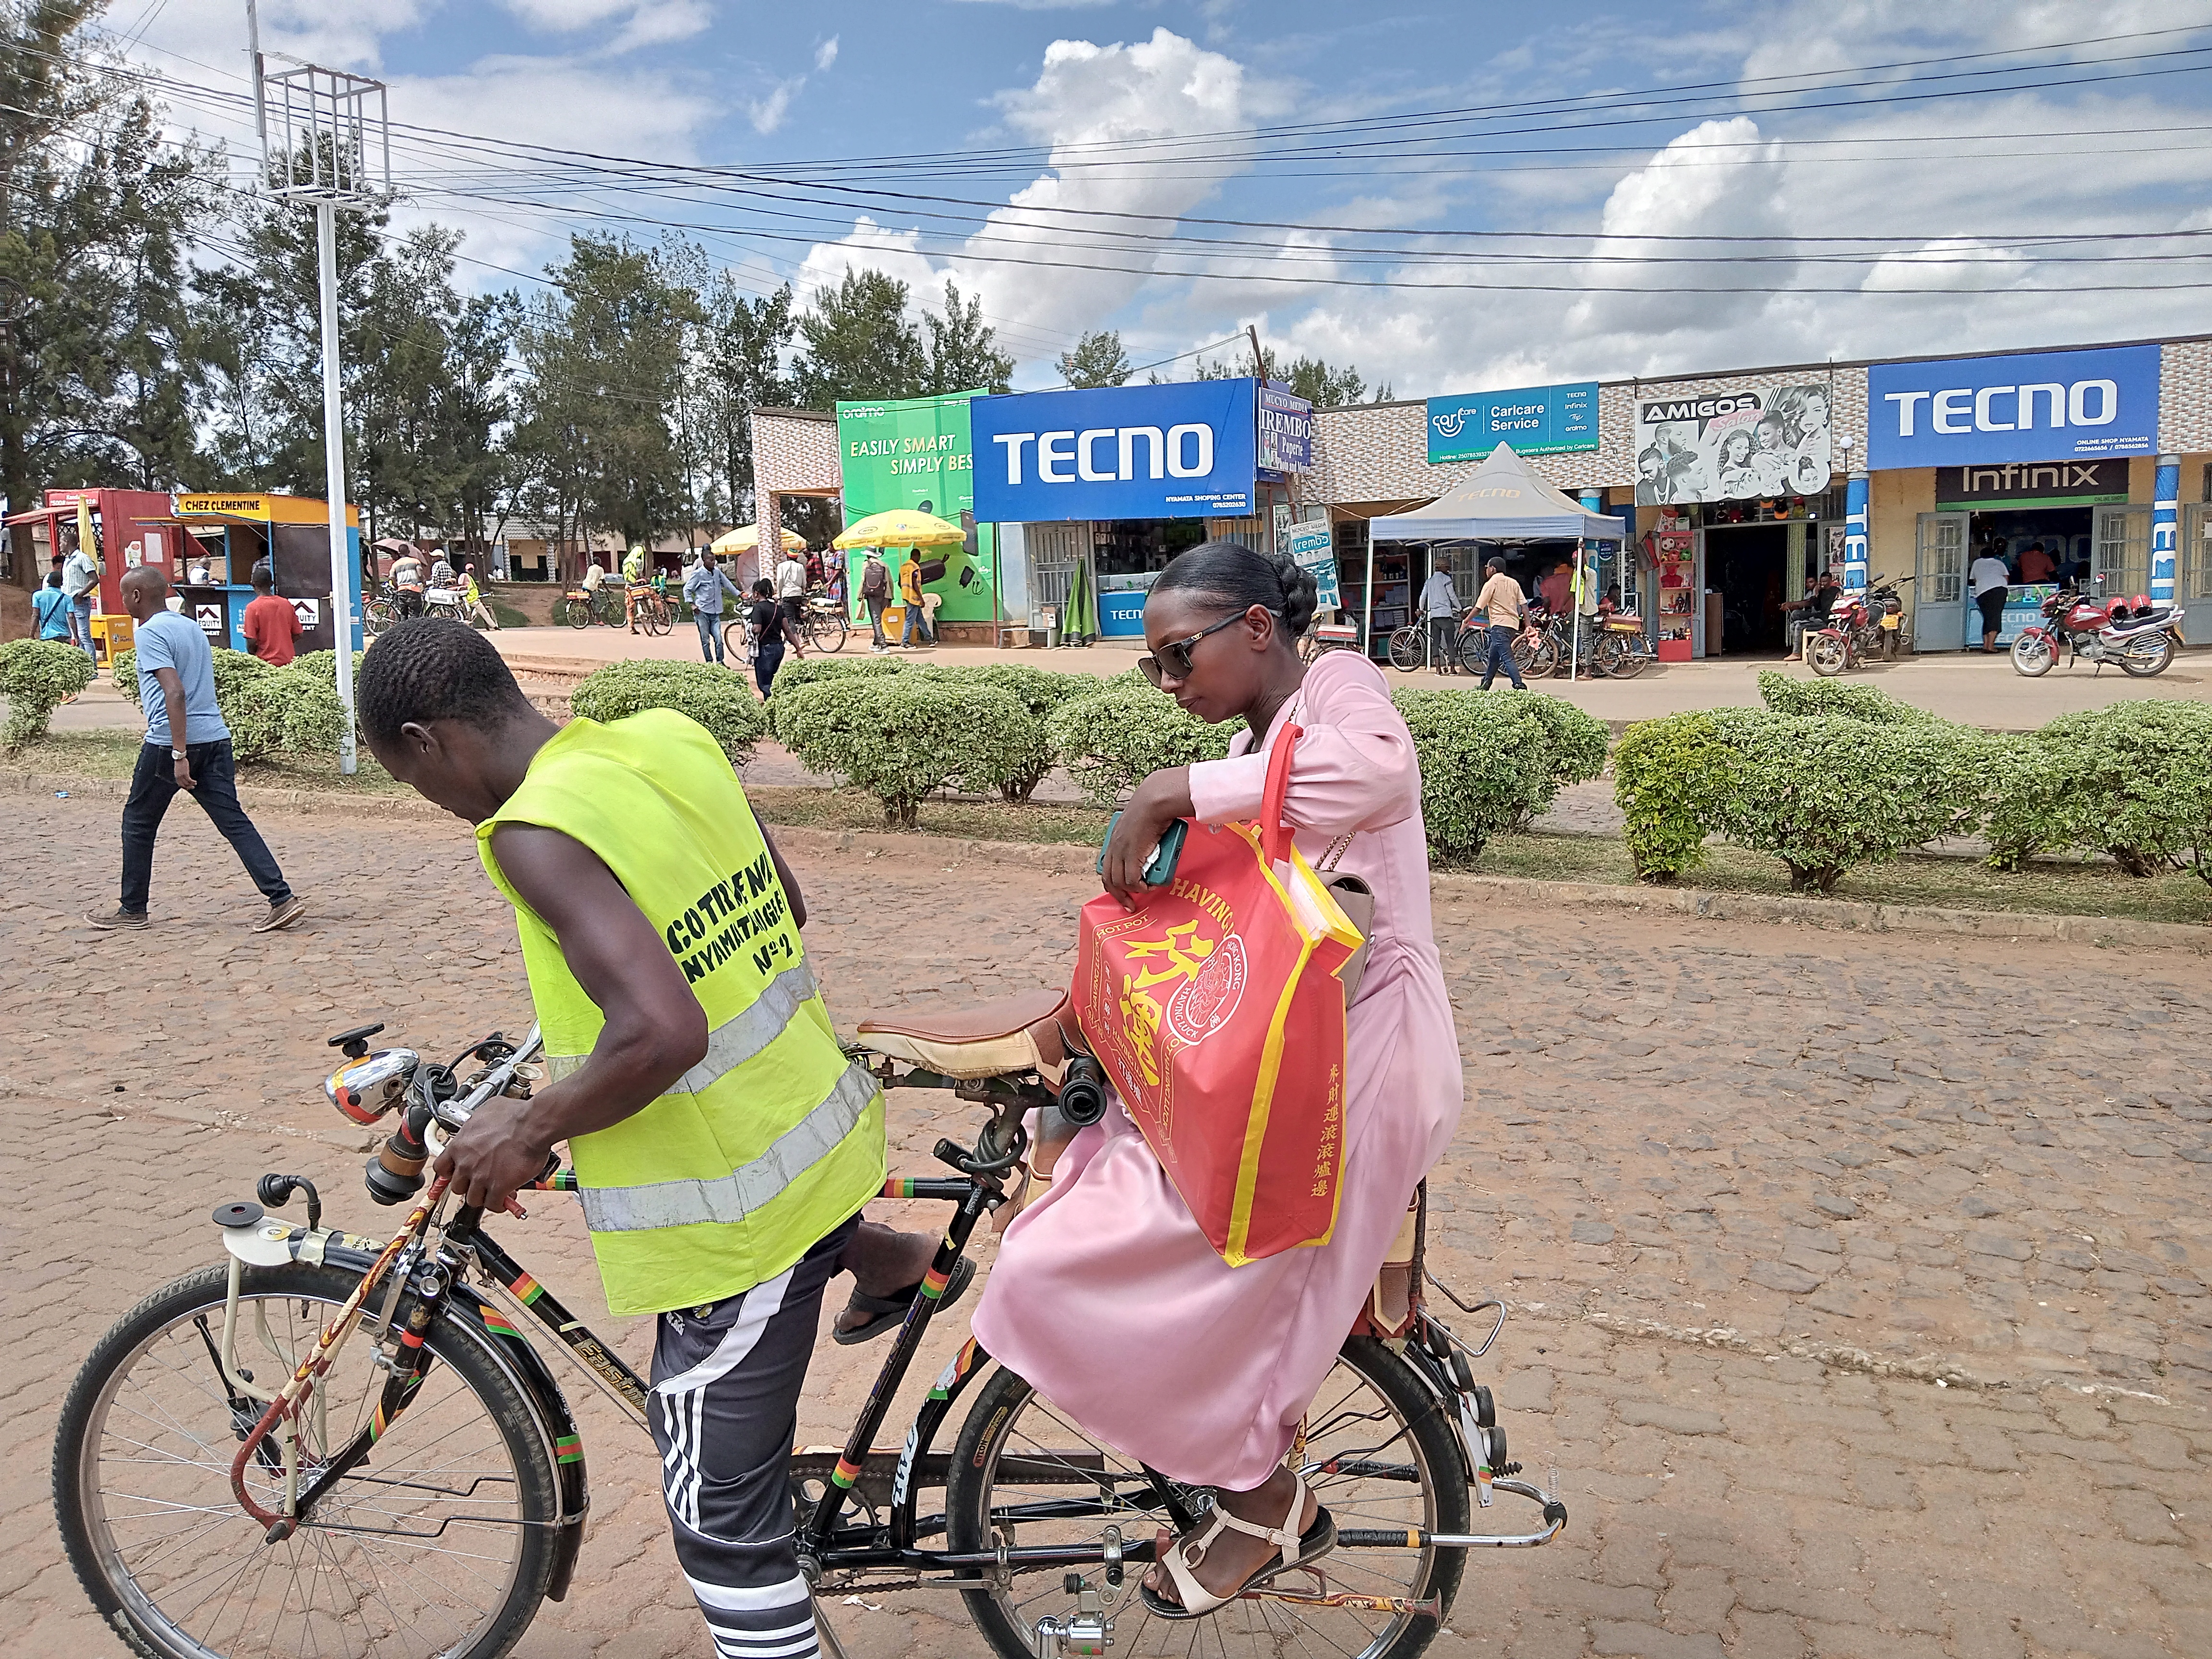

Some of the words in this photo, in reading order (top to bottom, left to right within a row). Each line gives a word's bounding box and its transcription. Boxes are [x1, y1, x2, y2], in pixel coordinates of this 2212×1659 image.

[842, 407, 885, 419] oraimo
[1265, 393, 1287, 409] MUCYO
[1290, 400, 1308, 413] MEDIA
[1491, 404, 1545, 418] Carlcare
[1645, 397, 1755, 421] AMIGOS
[1884, 379, 2118, 437] TECNO
[1261, 409, 1311, 440] IREMBO
[1491, 418, 1539, 432] Service
[1712, 410, 1760, 431] Salon
[850, 439, 900, 457] EASILY
[903, 434, 956, 454] SMART
[993, 423, 1214, 485] TECNO
[1282, 436, 1303, 458] Paperie
[890, 456, 944, 475] SIMPLY
[949, 454, 973, 471] BES
[1963, 462, 2100, 492] Infinix
[185, 501, 209, 510] CHEZ
[211, 500, 260, 510] CLEMENTINE
[1457, 488, 1521, 502] TECNO
[1292, 526, 1309, 534] MUCYO
[1294, 534, 1329, 550] irembo
[1110, 609, 1144, 620] TECN
[2001, 613, 2035, 623] ECNO
[1169, 878, 1233, 930] HAVING
[1096, 925, 1121, 939] HOT
[1123, 914, 1148, 929] POT
[1232, 955, 1241, 990] KONG
[1174, 986, 1191, 1021] HAVING
[1178, 1022, 1199, 1038] LUCK
[1166, 1038, 1181, 1056] OT
[573, 1338, 647, 1415] Eastm
